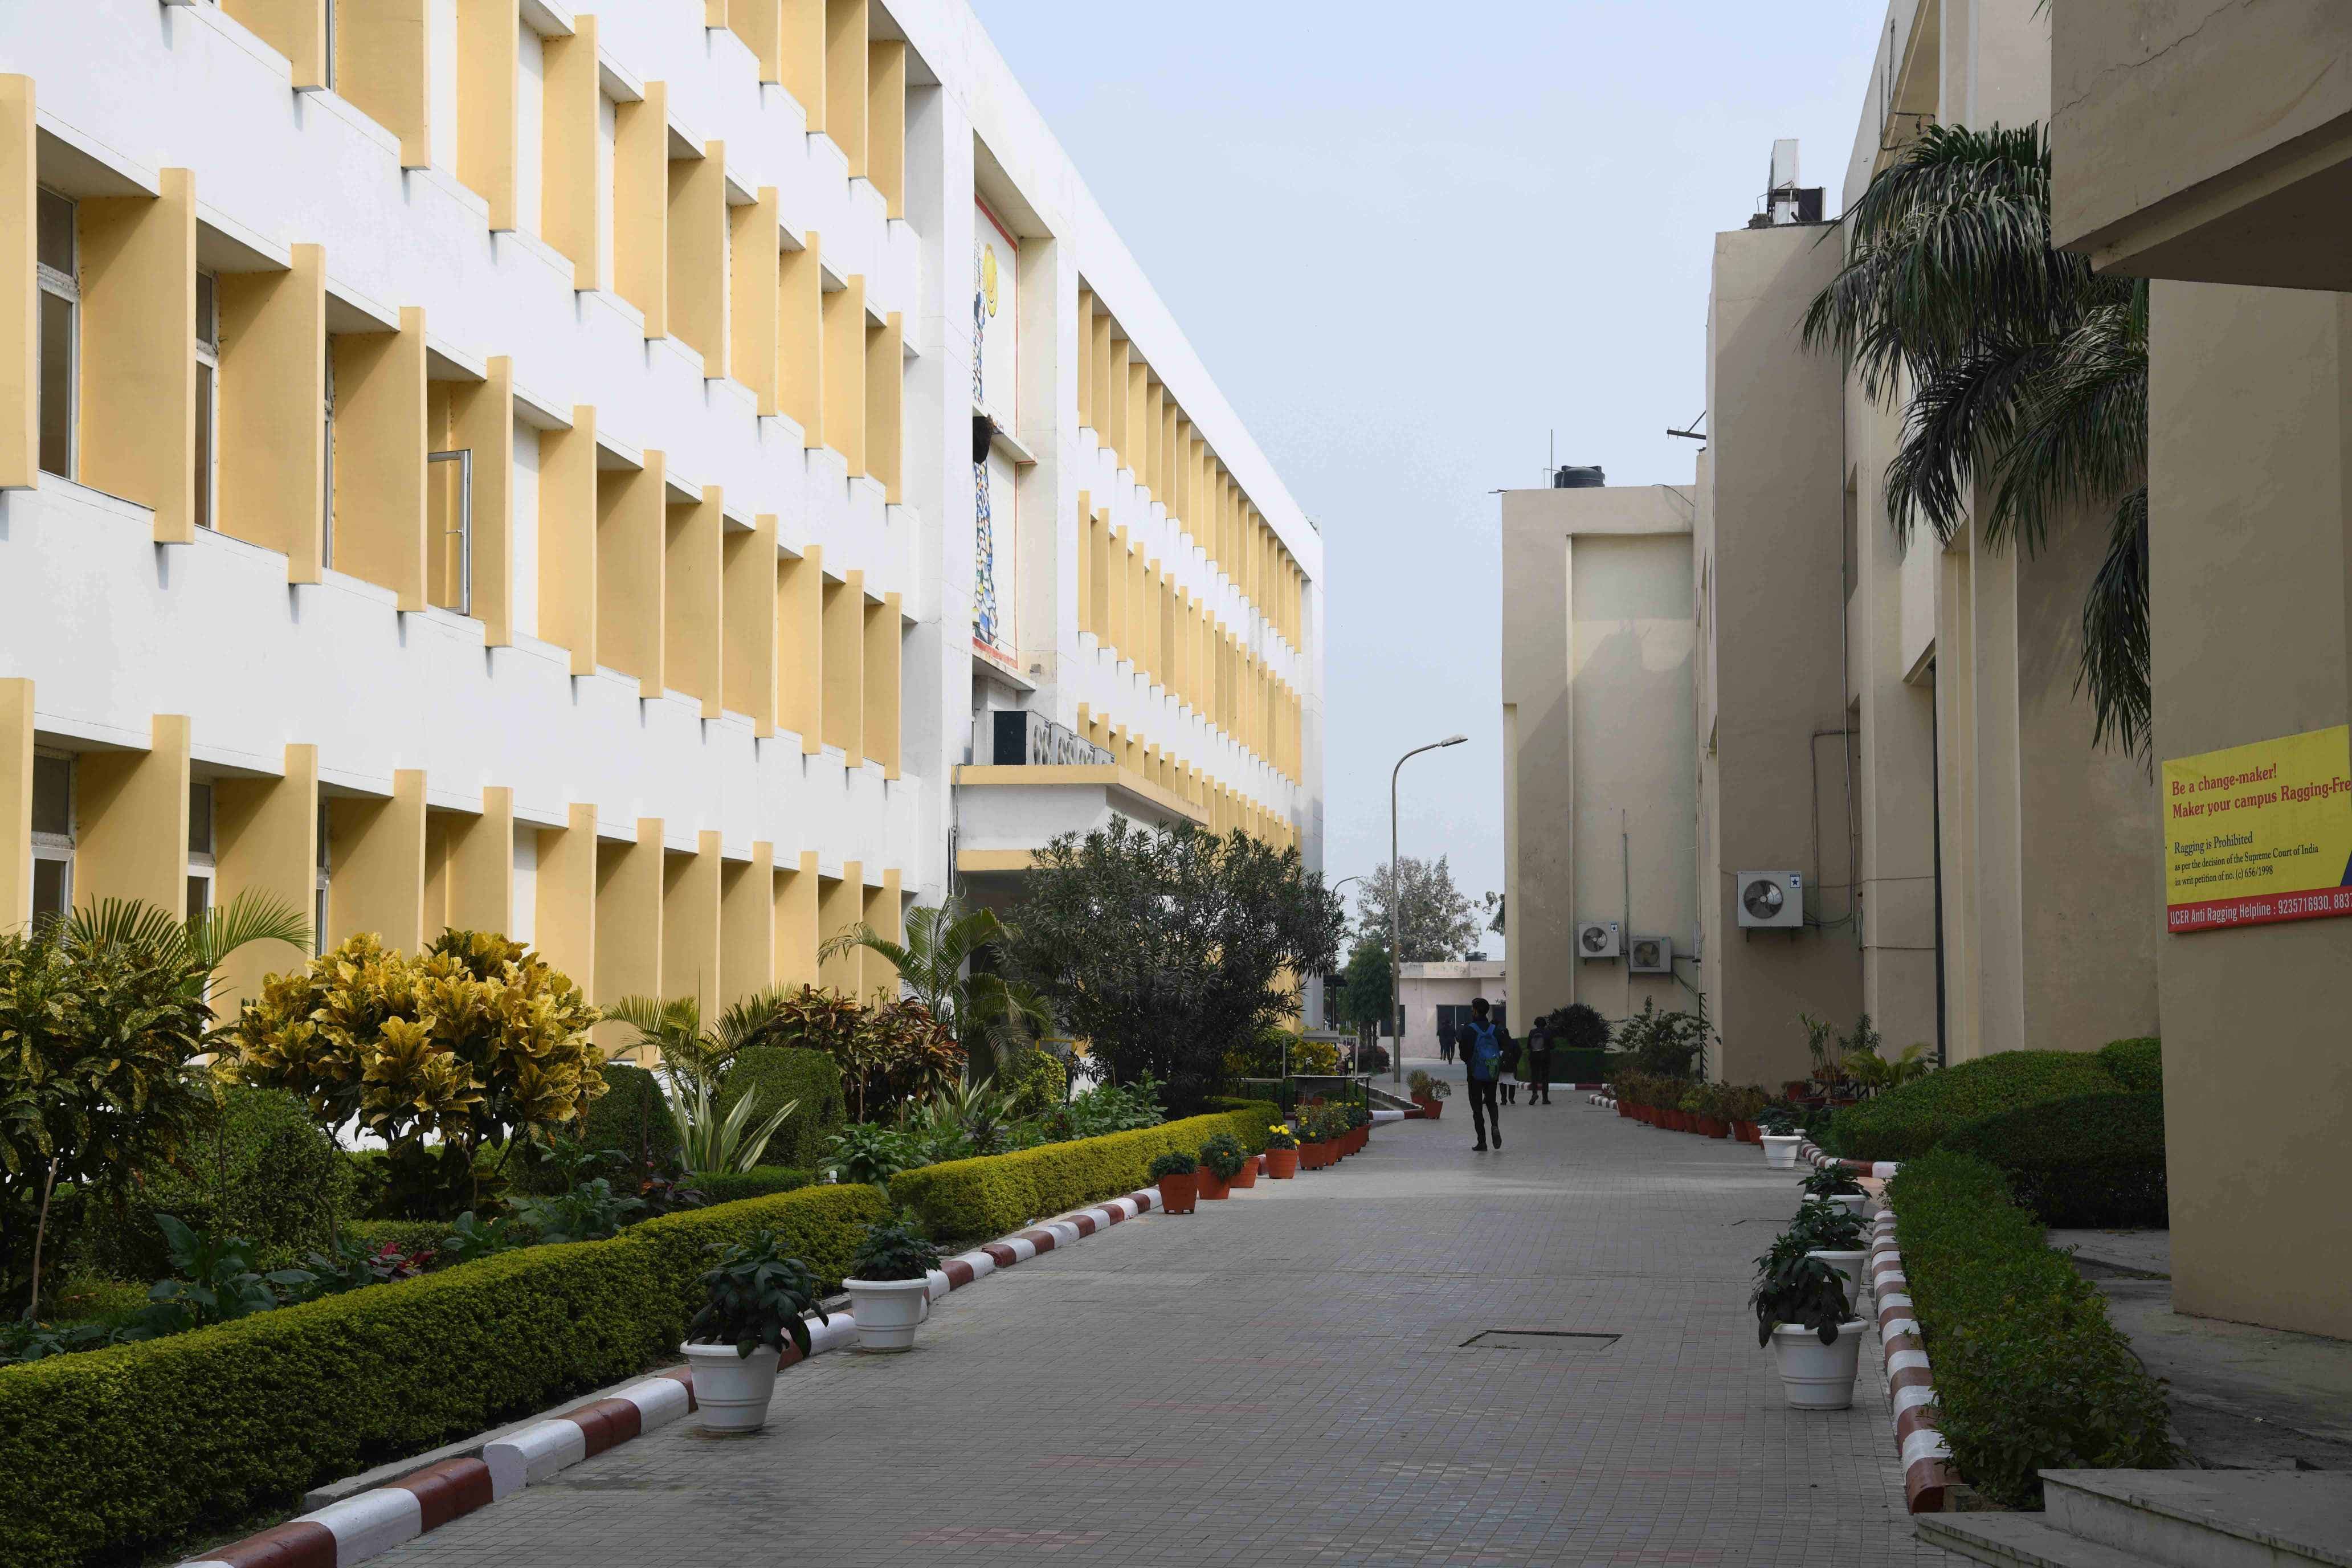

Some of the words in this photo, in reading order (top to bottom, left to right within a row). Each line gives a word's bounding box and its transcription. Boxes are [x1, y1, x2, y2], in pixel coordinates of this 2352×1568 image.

[2172, 781, 2186, 796] Be
[2188, 783, 2195, 793] a
[2198, 762, 2277, 790] change-maker!
[2173, 801, 2204, 819] Maker
[2207, 799, 2231, 816] your
[2234, 792, 2277, 808] campus
[2174, 840, 2204, 856] Ragging
[2206, 839, 2212, 850] is
[2214, 831, 2253, 848] Prohibited
[2181, 863, 2191, 873] per
[2191, 859, 2201, 868] the
[2202, 858, 2226, 868] decision
[2226, 854, 2233, 864] of
[2233, 854, 2243, 863] the
[2244, 851, 2271, 864] Supreme
[2273, 848, 2294, 858] Court
[2293, 844, 2301, 855] of
[2301, 843, 2319, 855] India
[2175, 877, 2181, 886] in
[2182, 876, 2194, 885] writ
[2194, 873, 2217, 887] petition
[2218, 870, 2225, 881] of
[2235, 868, 2244, 881] (c)
[2244, 865, 2274, 878] 656/1998
[2170, 910, 2190, 925] UCER
[2191, 908, 2206, 923] Anti
[2207, 905, 2238, 923] Ragging
[2239, 902, 2272, 920] Helpline
[2278, 895, 2331, 915] 9235716930,
